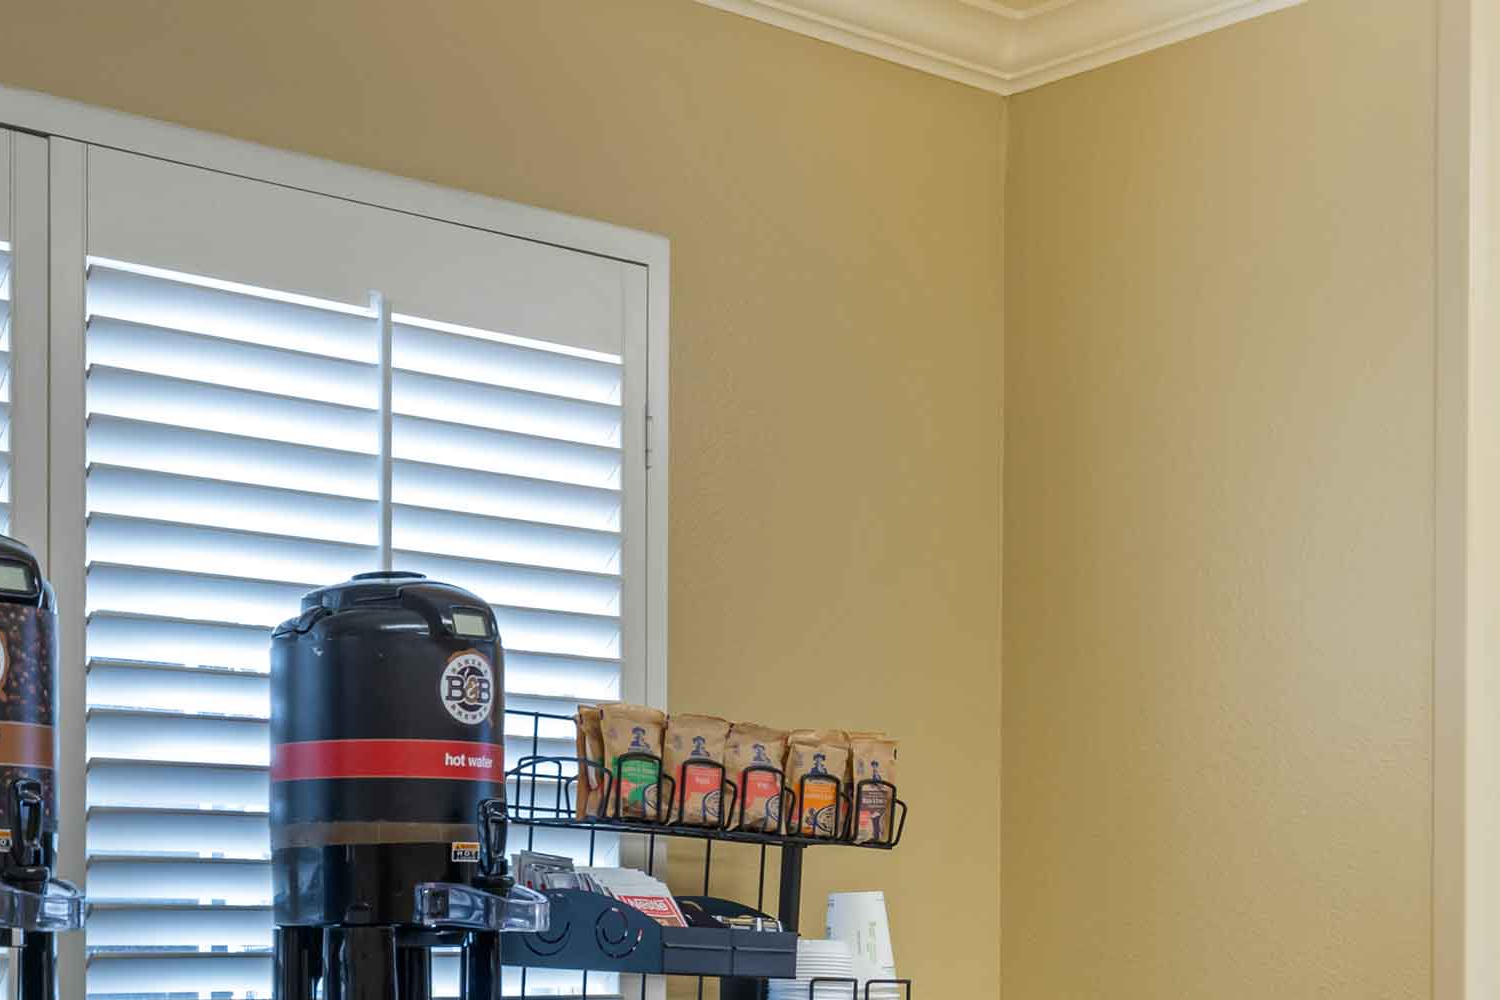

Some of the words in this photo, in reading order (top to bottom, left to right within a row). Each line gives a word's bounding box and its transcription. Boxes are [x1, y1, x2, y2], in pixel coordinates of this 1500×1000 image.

[446, 674, 491, 704] B&B
[445, 752, 467, 767] hot
[468, 756, 493, 768] water
